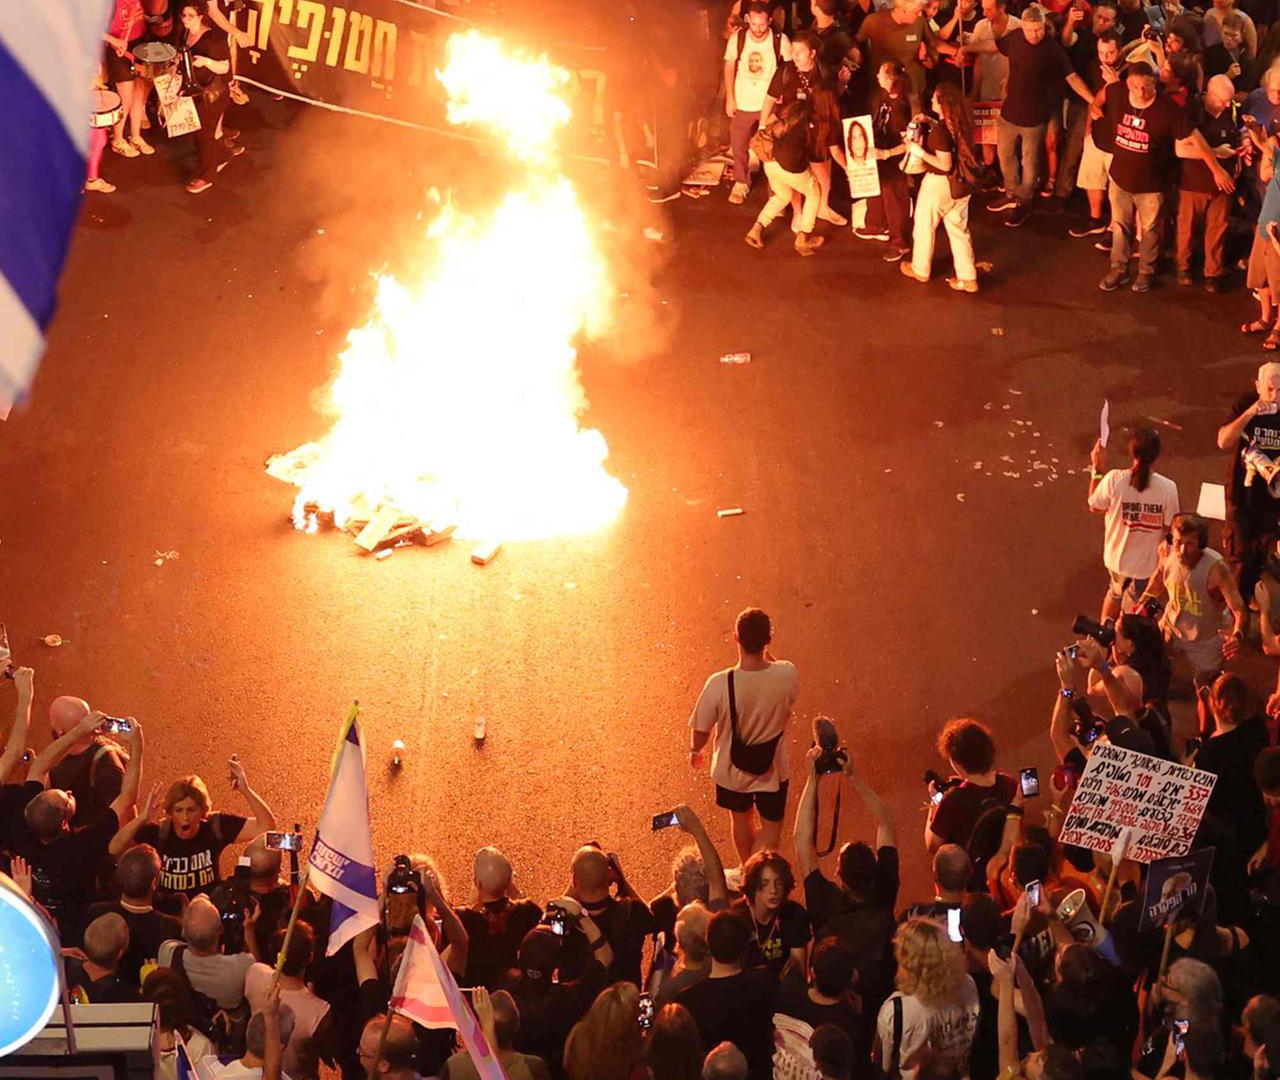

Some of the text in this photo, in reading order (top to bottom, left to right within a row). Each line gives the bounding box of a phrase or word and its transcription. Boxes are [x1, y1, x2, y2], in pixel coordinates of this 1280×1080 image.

[1134, 773, 1152, 788] 101
[1184, 785, 1209, 803] 337
[191, 849, 213, 871] אתם
[200, 866, 215, 886] הם
